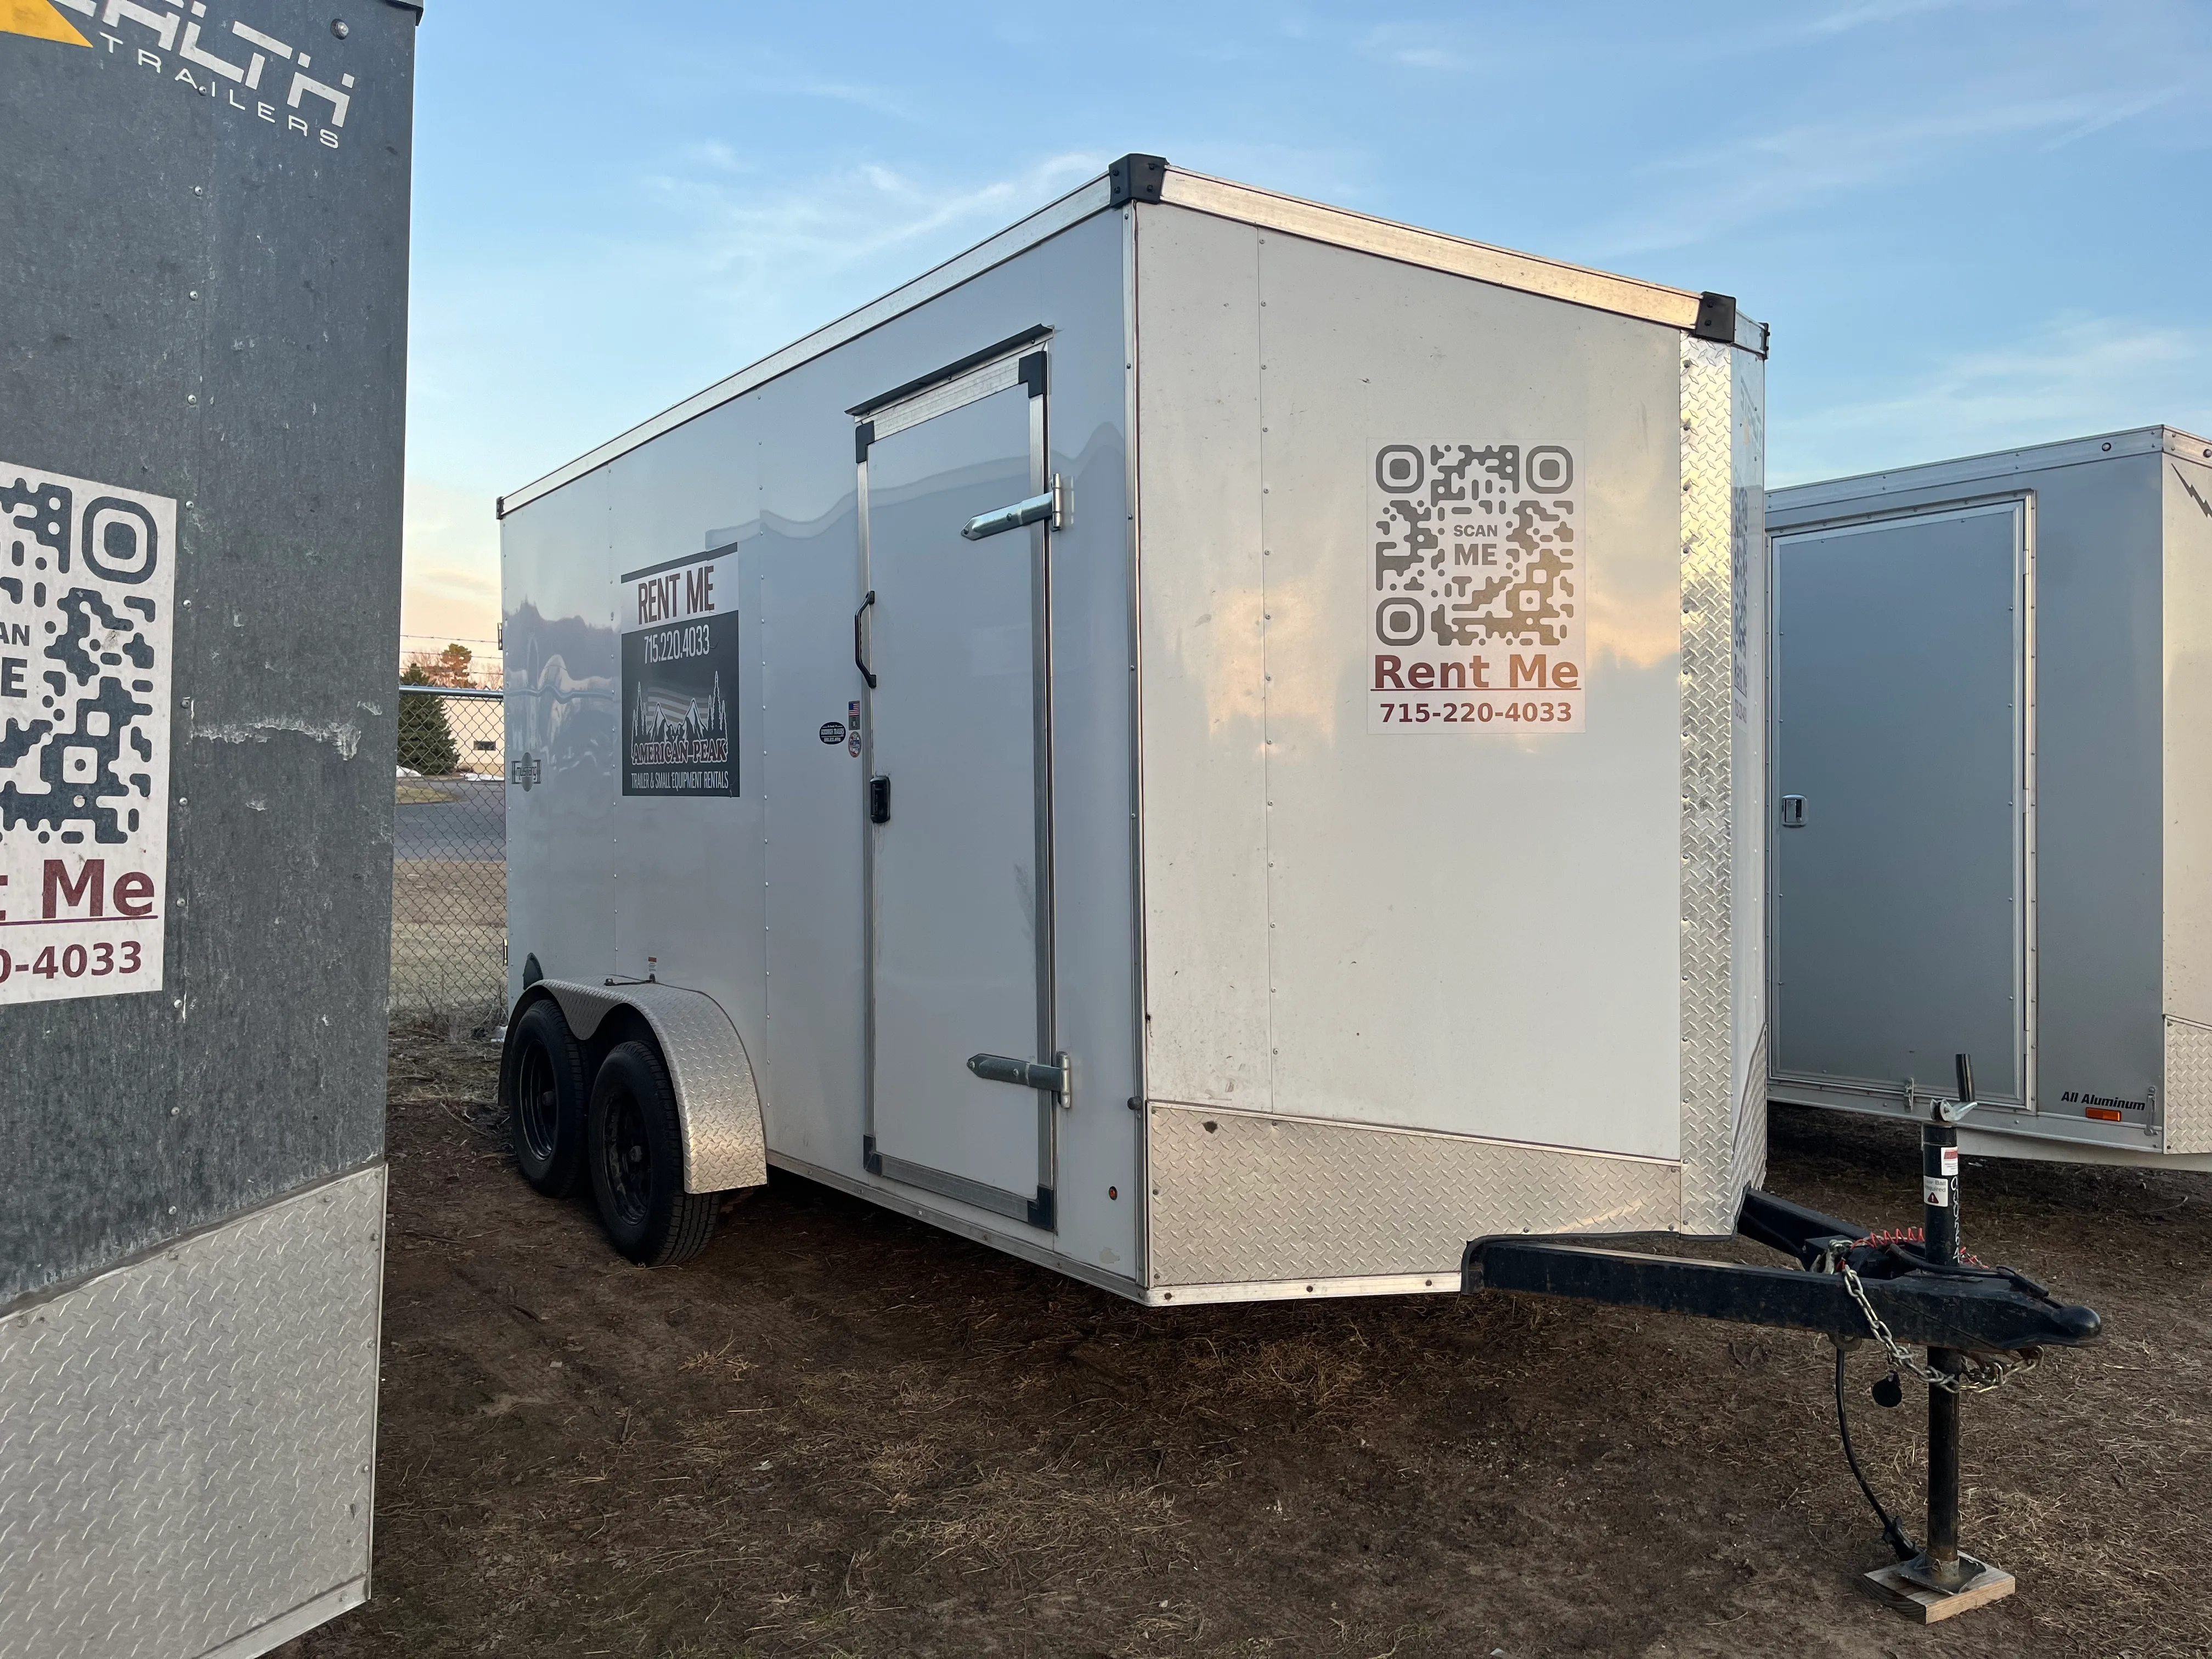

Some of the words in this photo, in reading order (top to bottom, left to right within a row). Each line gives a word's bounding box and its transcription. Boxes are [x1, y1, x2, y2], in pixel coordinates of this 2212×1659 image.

[99, 31, 339, 149] TRAILERS
[1453, 524, 1498, 537] SCAN
[1454, 544, 1497, 566] ME
[638, 573, 681, 625] RENT
[687, 566, 715, 614] ME
[644, 624, 710, 664] 715.220.4033
[1375, 654, 1489, 689] Rent
[1509, 654, 1579, 689] Me
[1380, 702, 1572, 723] 715-220-4033
[632, 741, 689, 765] AMERICAN
[692, 738, 727, 763] PEAK
[631, 772, 649, 789] TRAILER
[650, 772, 654, 789] &
[655, 772, 670, 789] SMALL
[671, 771, 702, 791] EQUIPMENT
[704, 771, 729, 789] RENTALS
[42, 859, 155, 919] Me
[2061, 1091, 2079, 1103] All
[2081, 1094, 2146, 1110] Aluminum
